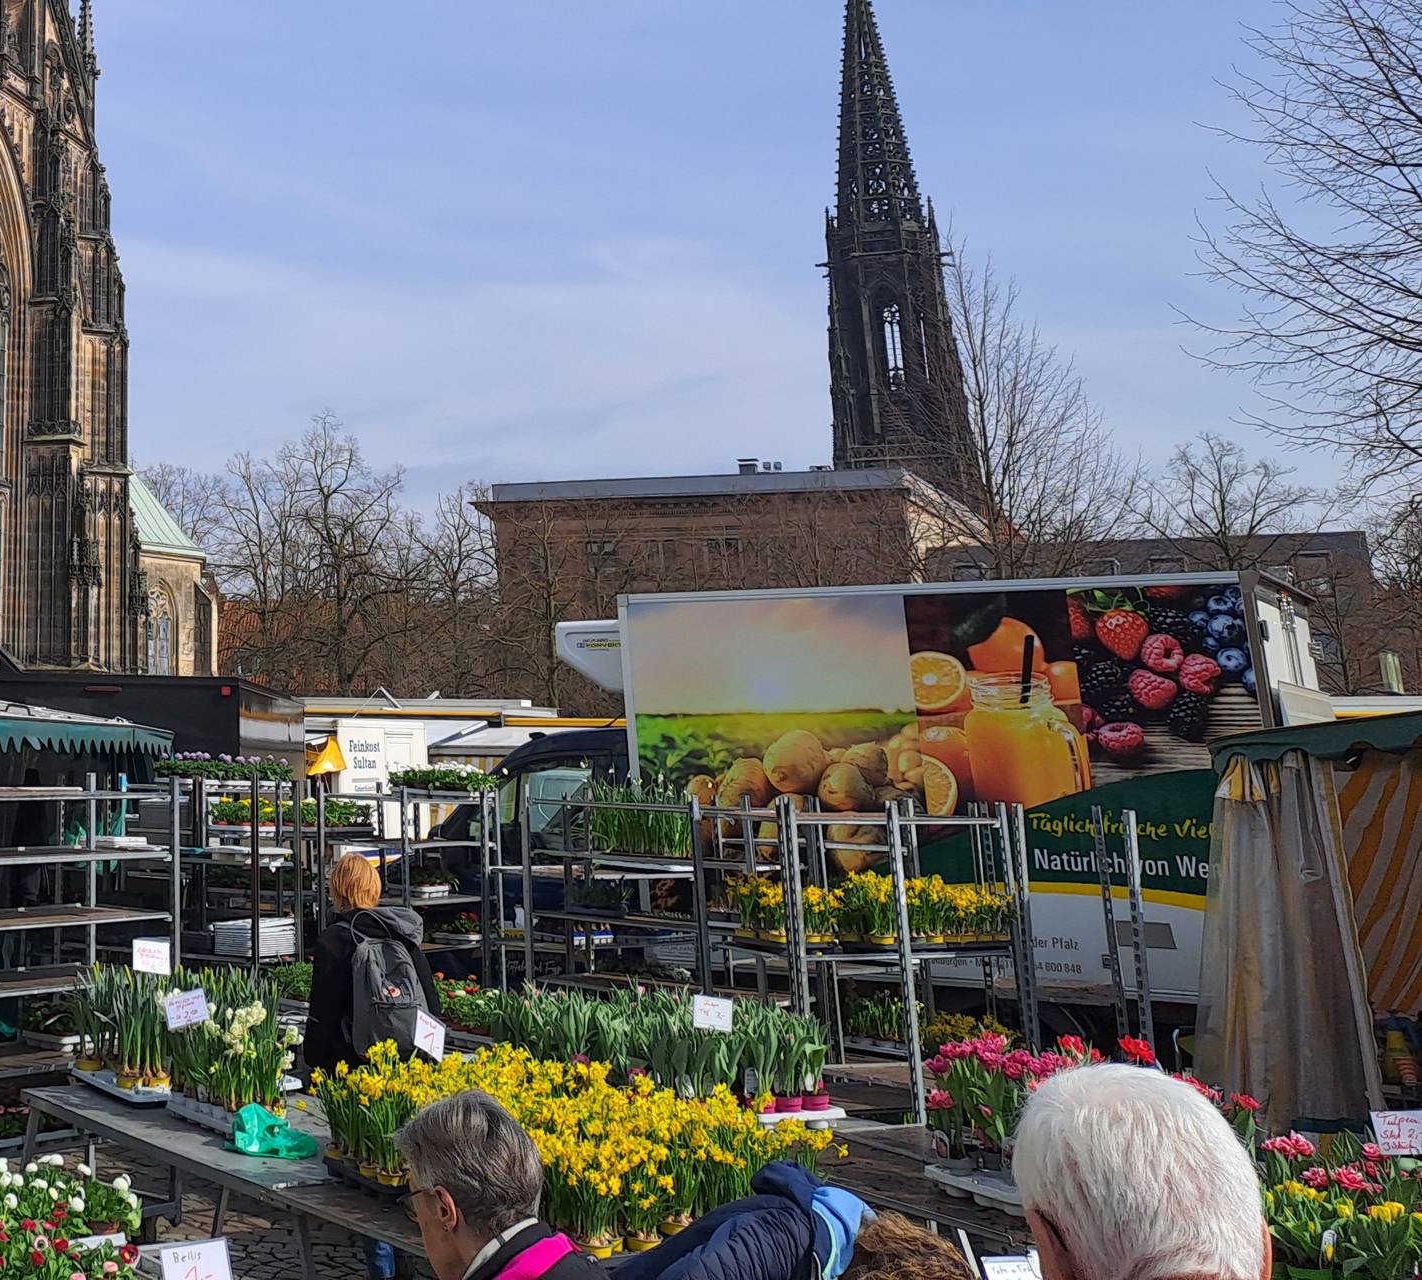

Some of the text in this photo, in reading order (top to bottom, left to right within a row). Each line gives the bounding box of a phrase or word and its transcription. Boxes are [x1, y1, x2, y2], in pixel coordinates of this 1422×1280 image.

[349, 739, 381, 753] Feinkost
[353, 756, 377, 769] Sultan
[1028, 812, 1096, 838] Täglich
[1103, 810, 1169, 841] friche
[1052, 937, 1079, 951] Pfalz
[172, 1249, 202, 1264] Bellis
